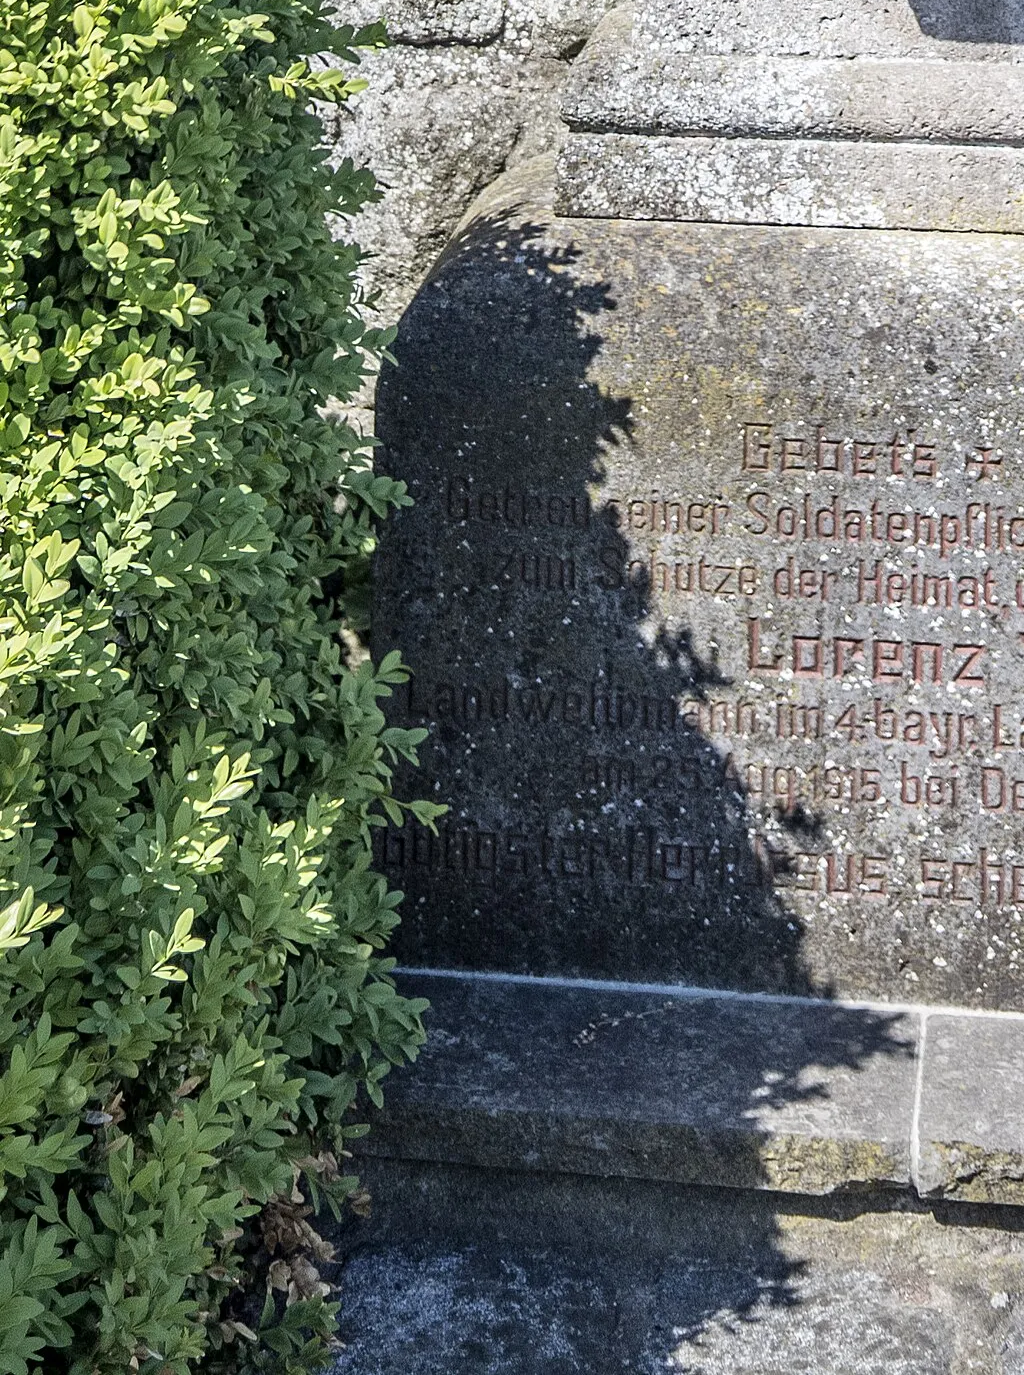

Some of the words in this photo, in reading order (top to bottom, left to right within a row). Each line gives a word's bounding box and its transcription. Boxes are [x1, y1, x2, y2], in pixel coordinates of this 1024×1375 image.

[741, 421, 938, 481] Gebets
[446, 475, 591, 526] Getreu
[596, 489, 730, 535] seiner
[492, 546, 577, 590] zum
[774, 555, 838, 600] der
[745, 616, 987, 686] Lorenz
[407, 671, 761, 735] Landwehrmann
[776, 693, 825, 738] im
[581, 755, 636, 791] am
[899, 760, 959, 808] bei
[626, 825, 741, 887] Herr
